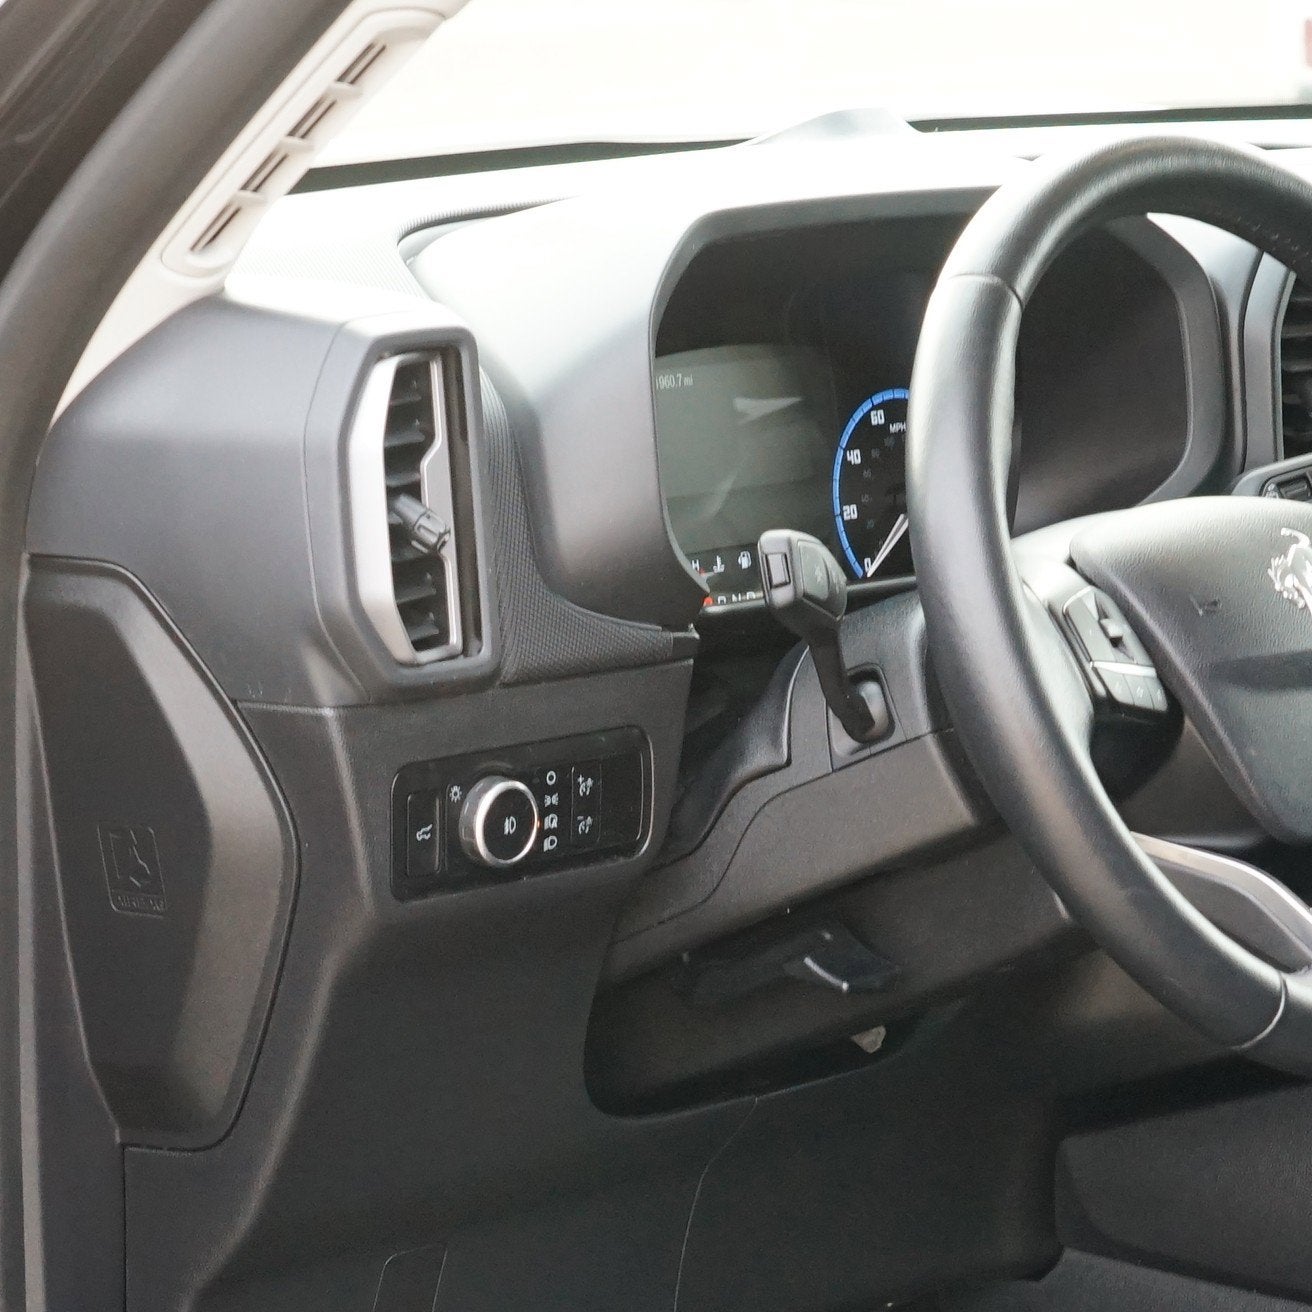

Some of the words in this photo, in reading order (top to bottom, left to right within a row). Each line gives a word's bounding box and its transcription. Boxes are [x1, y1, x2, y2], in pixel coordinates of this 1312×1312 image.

[871, 409, 885, 426] 60
[890, 421, 907, 434] MPH
[847, 449, 861, 465] 40
[843, 504, 857, 520] 20
